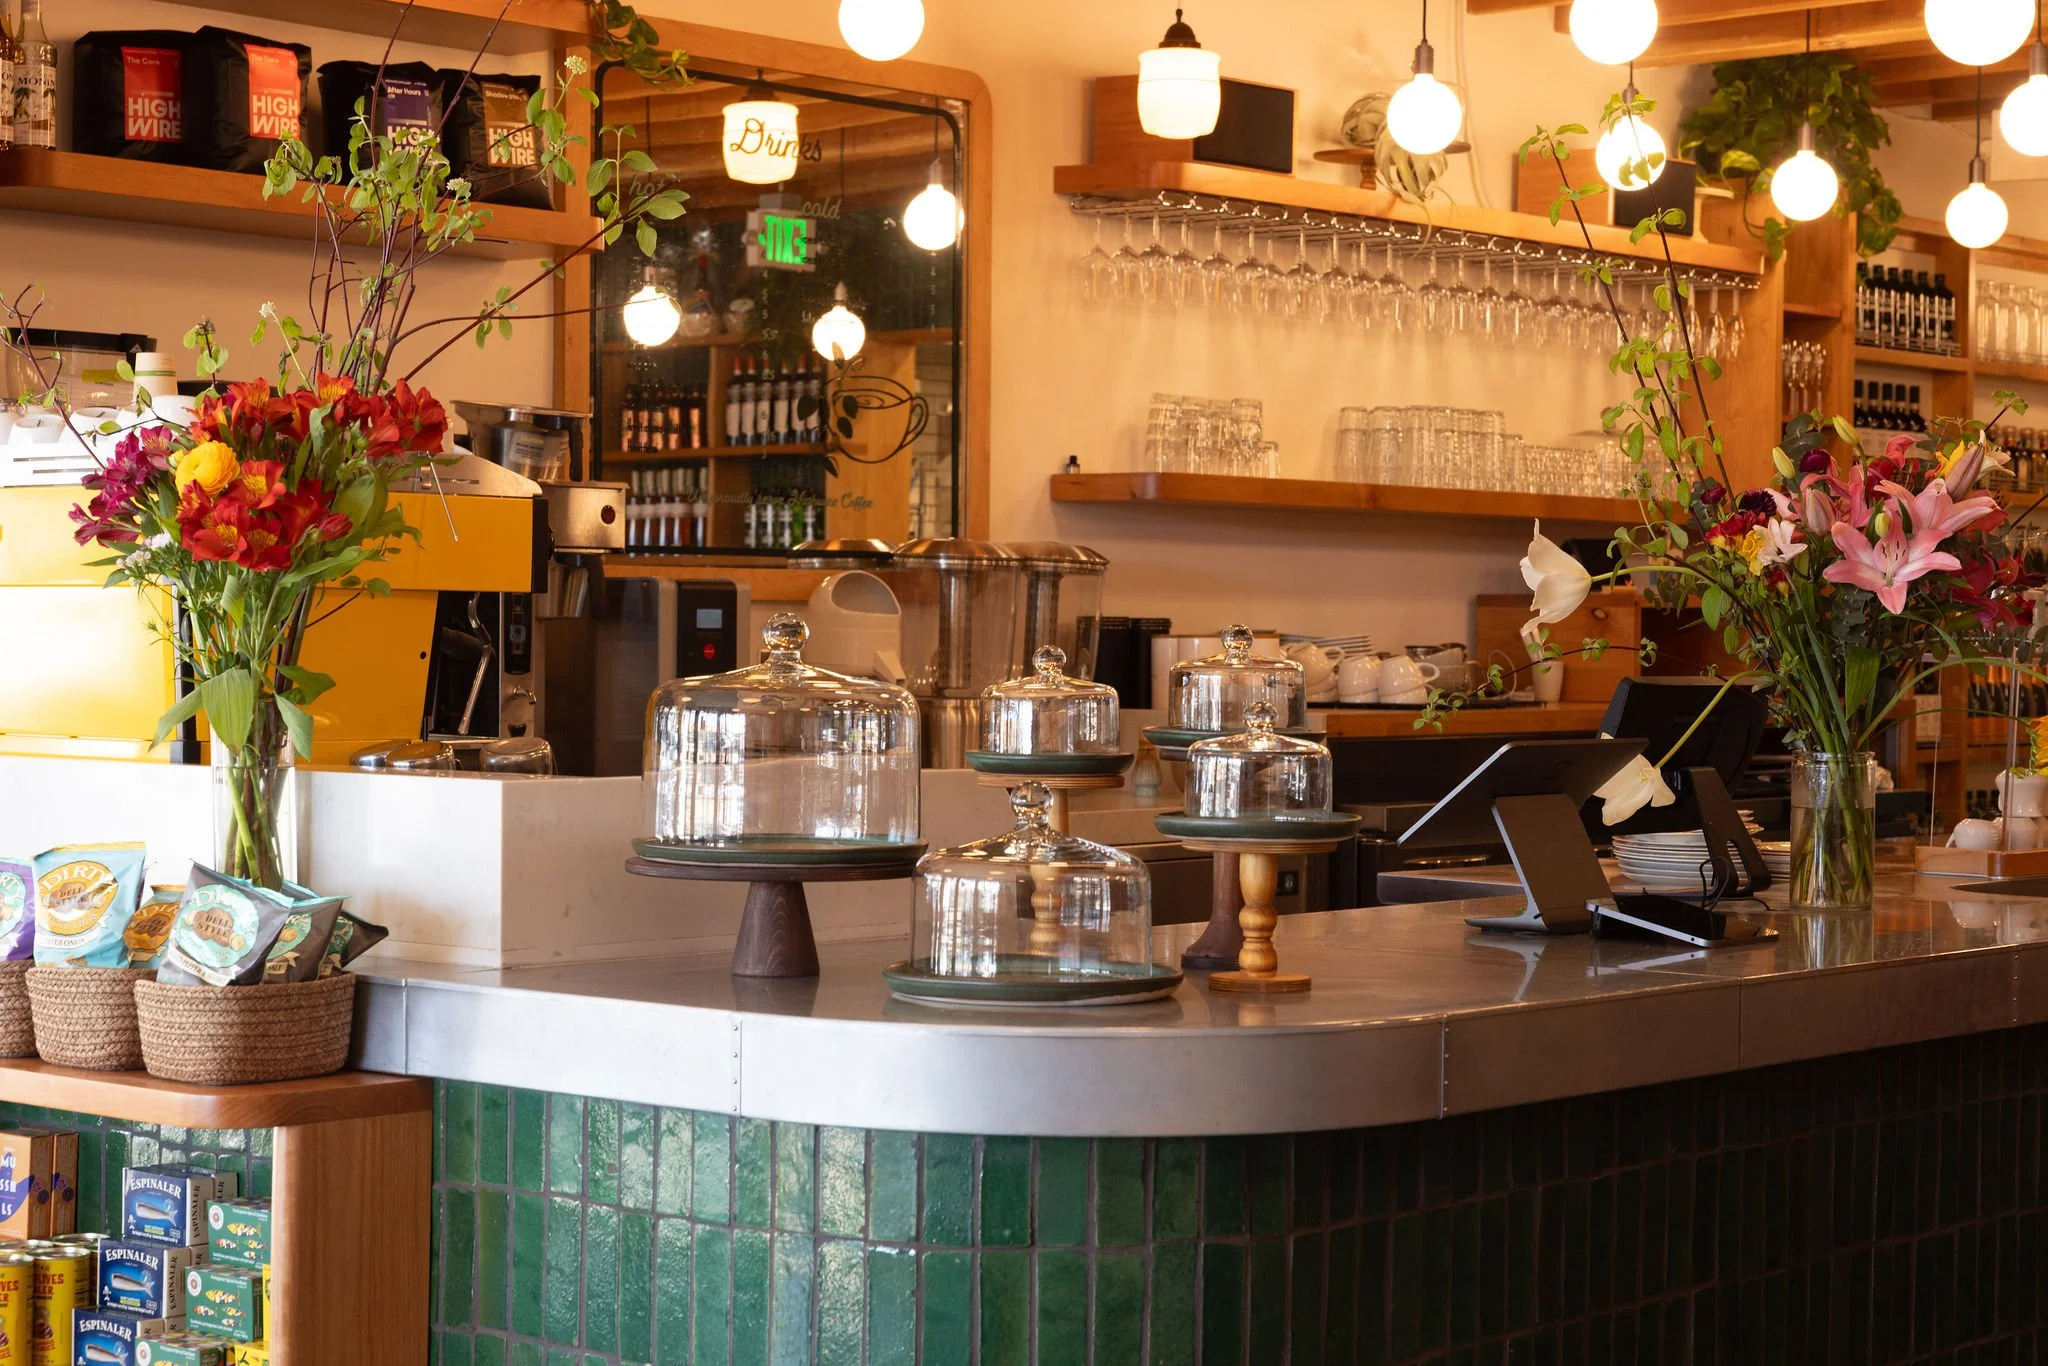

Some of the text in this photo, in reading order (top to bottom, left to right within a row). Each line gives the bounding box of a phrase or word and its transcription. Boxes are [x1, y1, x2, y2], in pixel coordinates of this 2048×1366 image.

[127, 56, 141, 64] The
[387, 86, 403, 94] After
[404, 88, 422, 96] Hours
[128, 96, 182, 119] HIGH
[252, 94, 299, 117] HIGH
[128, 117, 182, 139] WIRE
[252, 114, 299, 137] WIRE
[387, 125, 436, 146] HIG
[730, 117, 823, 162] Drinks
[489, 147, 536, 165] WIRE
[628, 174, 666, 197] hot
[802, 196, 842, 220] cold
[840, 493, 874, 512] Coffee
[42, 864, 114, 891] DIRTY
[60, 886, 83, 898] DELI
[197, 922, 230, 938] STYLE
[205, 914, 230, 927] DELI
[130, 1177, 182, 1200] ESPINALER
[191, 1184, 201, 1239] ESPINALER
[105, 1247, 159, 1271] ESPINALER
[168, 1256, 179, 1310] ESPINALER
[80, 1319, 132, 1342] ESPINALER
